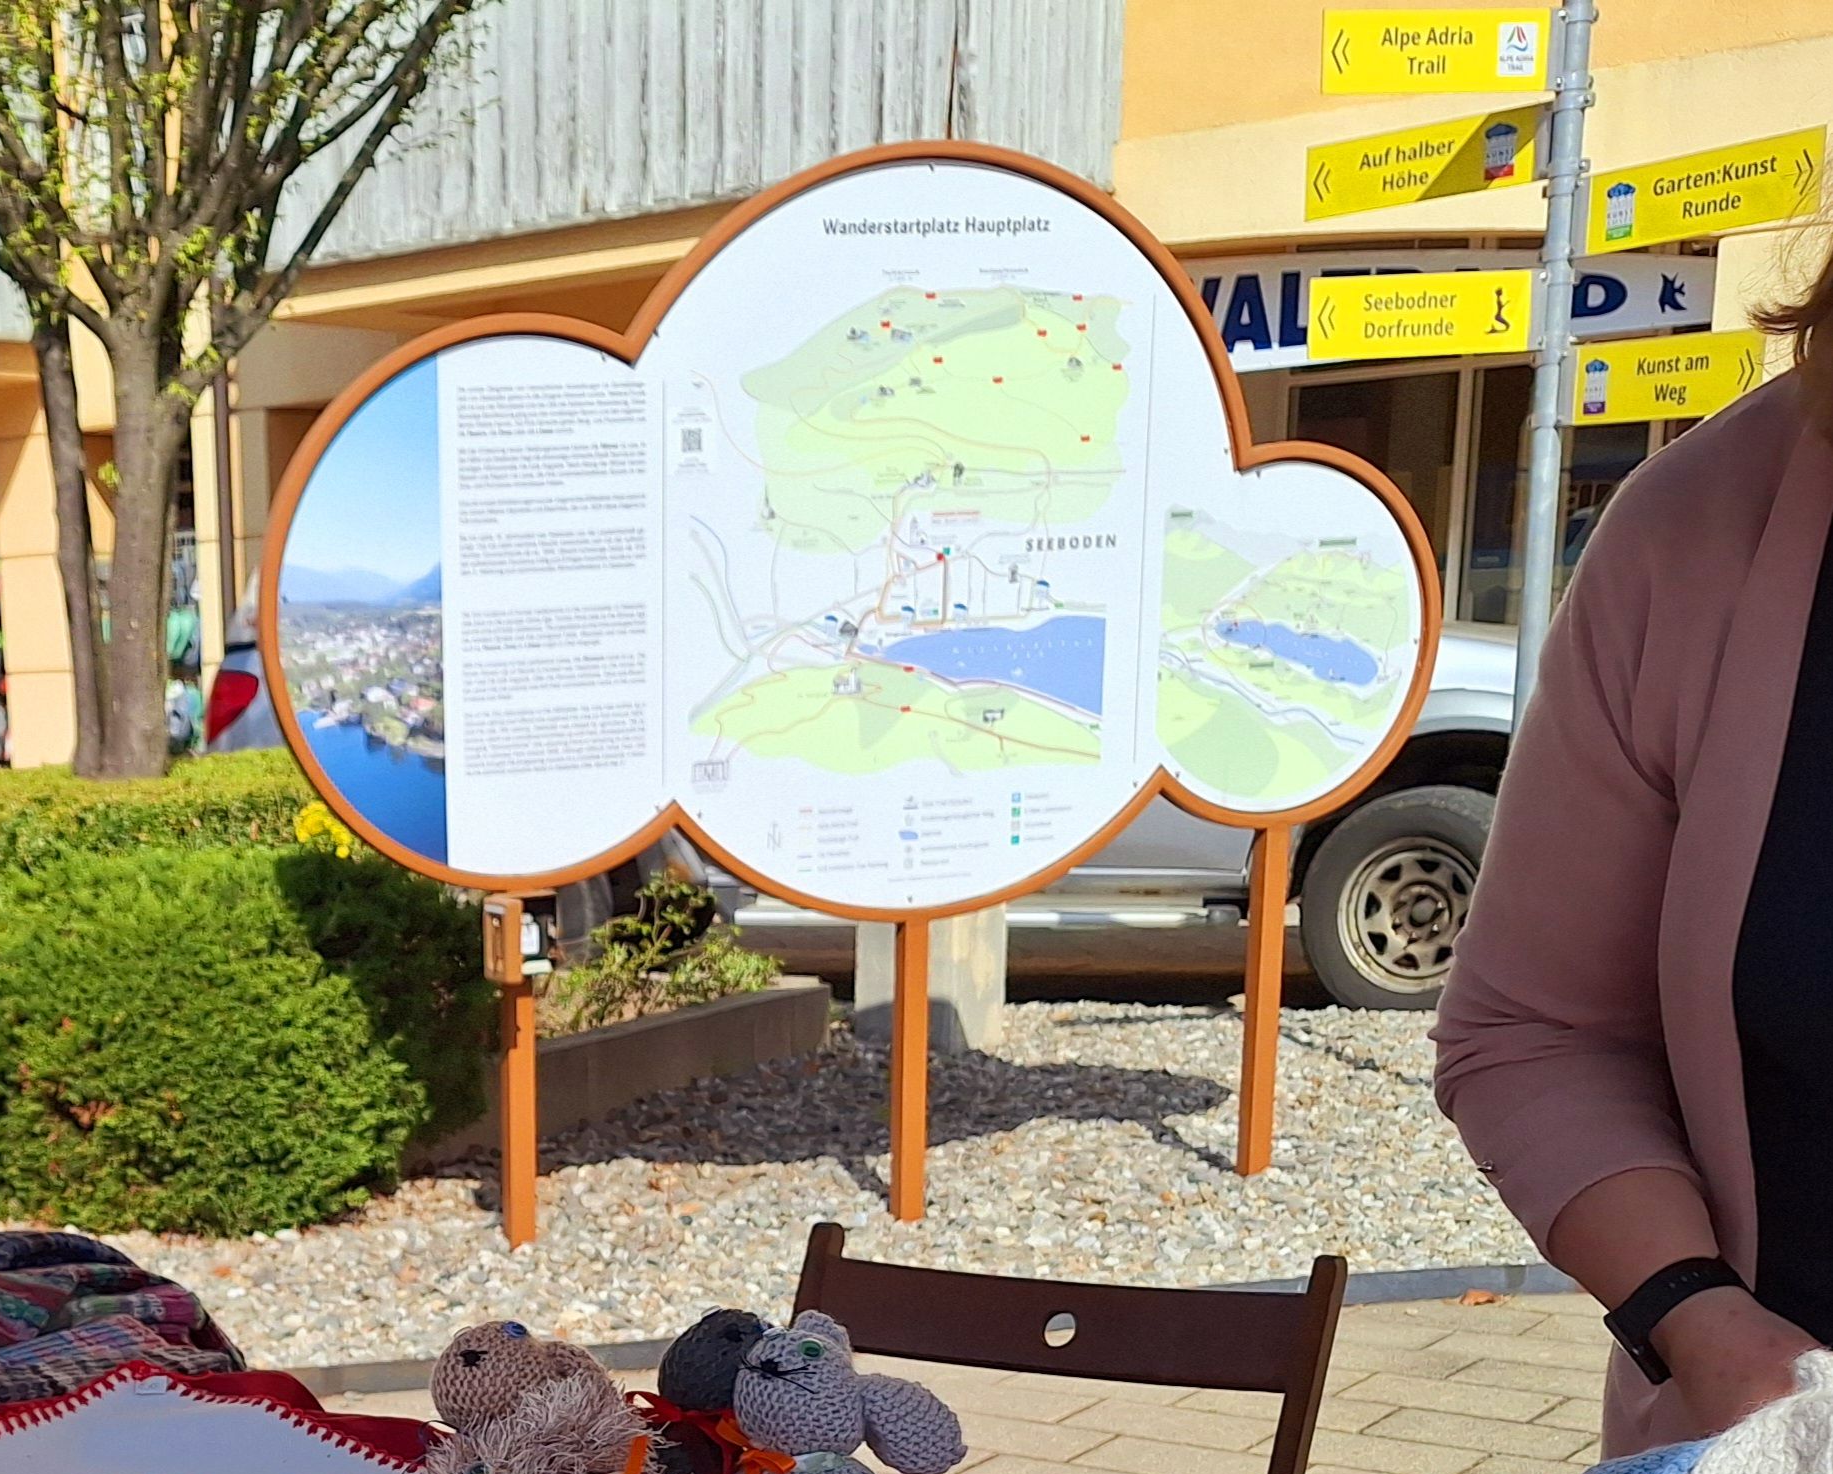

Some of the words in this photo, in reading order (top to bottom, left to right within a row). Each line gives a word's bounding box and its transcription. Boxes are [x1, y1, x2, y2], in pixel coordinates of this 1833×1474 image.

[1381, 27, 1421, 51] Alpe
[1425, 26, 1474, 46] Adria
[1407, 55, 1447, 75] Trail
[1359, 151, 1391, 171] Auf
[1396, 139, 1456, 164] halber
[1381, 169, 1430, 192] Höhe
[1653, 154, 1778, 197] Garten:Kunst
[1682, 191, 1742, 220] Runde
[822, 217, 960, 237] Wanderstartplatz
[965, 216, 1051, 236] Hauptplatz
[1363, 290, 1458, 311] Seebodner
[1364, 317, 1455, 340] Dorfrunde
[1636, 356, 1681, 376] Kunst
[1685, 355, 1710, 371] am
[1654, 383, 1687, 405] Weg
[1025, 533, 1118, 552] SEEBODEN
